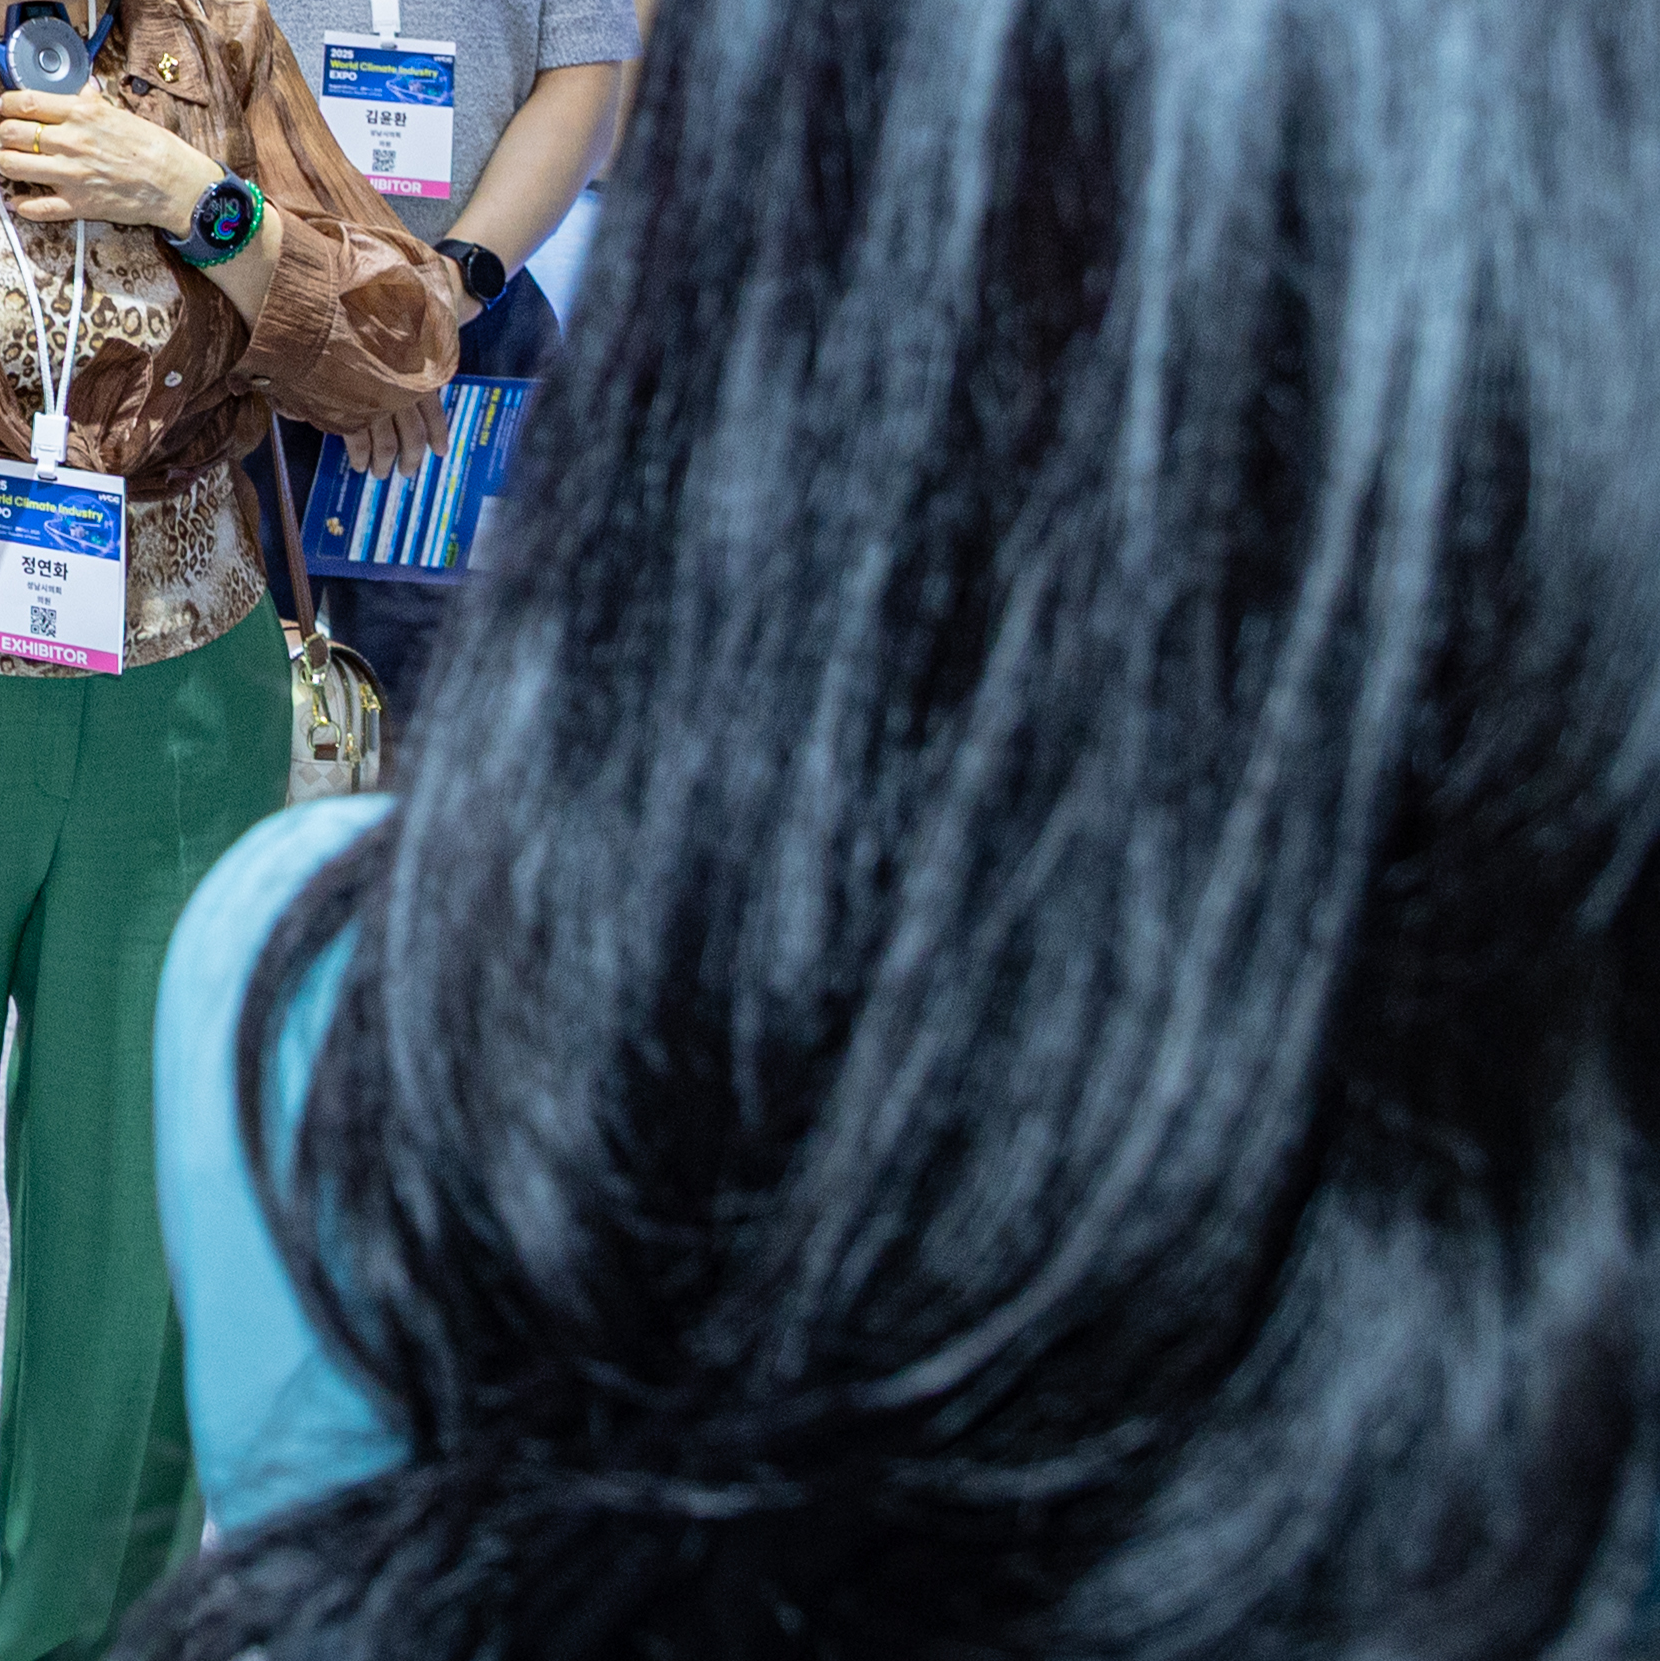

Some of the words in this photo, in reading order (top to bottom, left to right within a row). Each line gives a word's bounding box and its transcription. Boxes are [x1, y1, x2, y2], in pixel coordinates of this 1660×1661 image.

[330, 47, 355, 60] 2025
[329, 69, 358, 82] EXPO
[330, 59, 359, 71] World
[360, 60, 397, 74] Climate
[398, 65, 439, 79] Industry
[14, 496, 57, 513] Climate
[58, 503, 104, 523] Industry
[21, 555, 69, 581] 정연화
[0, 635, 88, 666] EXHIBITOR
